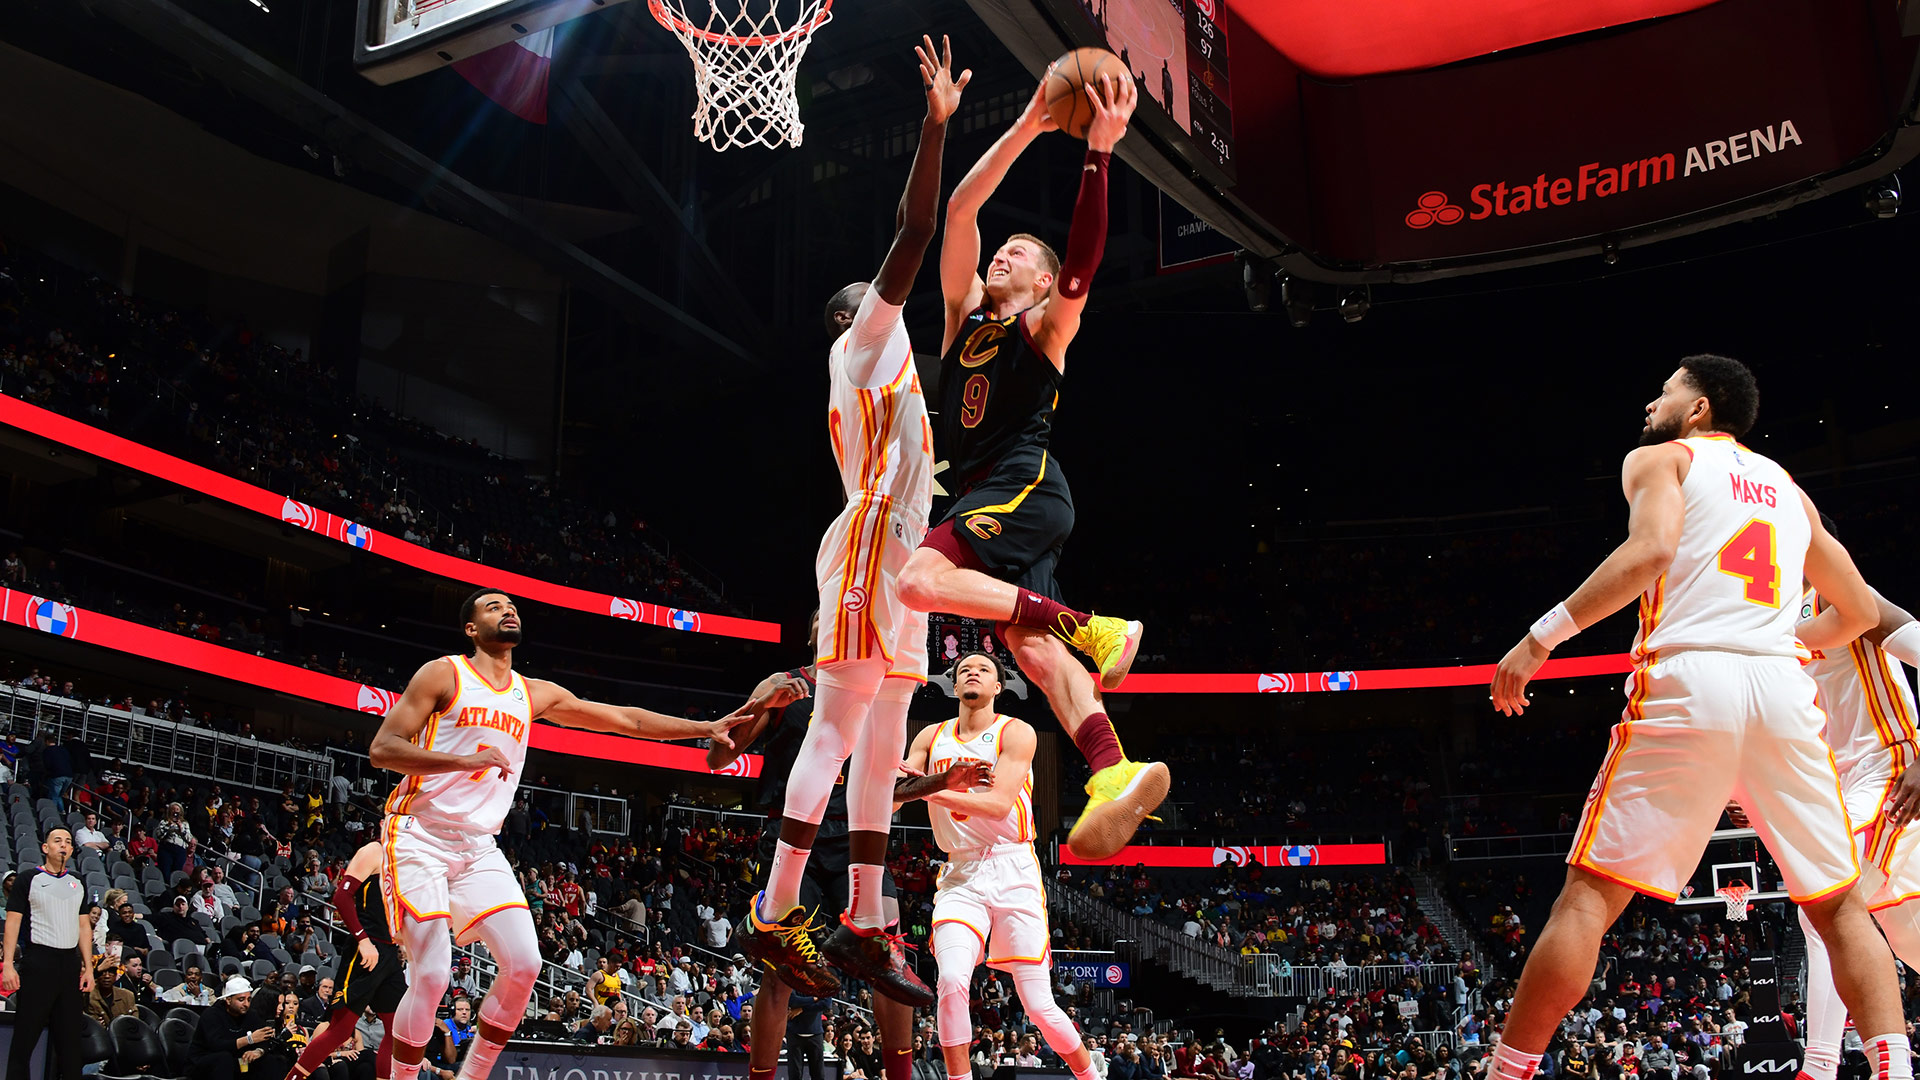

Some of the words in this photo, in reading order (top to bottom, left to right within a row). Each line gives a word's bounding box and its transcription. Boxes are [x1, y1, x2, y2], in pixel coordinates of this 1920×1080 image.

[1197, 11, 1214, 40] 126
[1200, 38, 1212, 59] 97
[1210, 132, 1230, 160] 2:31
[1683, 119, 1803, 178] ARENA
[960, 374, 990, 429] 9
[1729, 472, 1777, 509] MAYS
[1717, 517, 1781, 610] 4
[455, 706, 526, 745] ATLANTA
